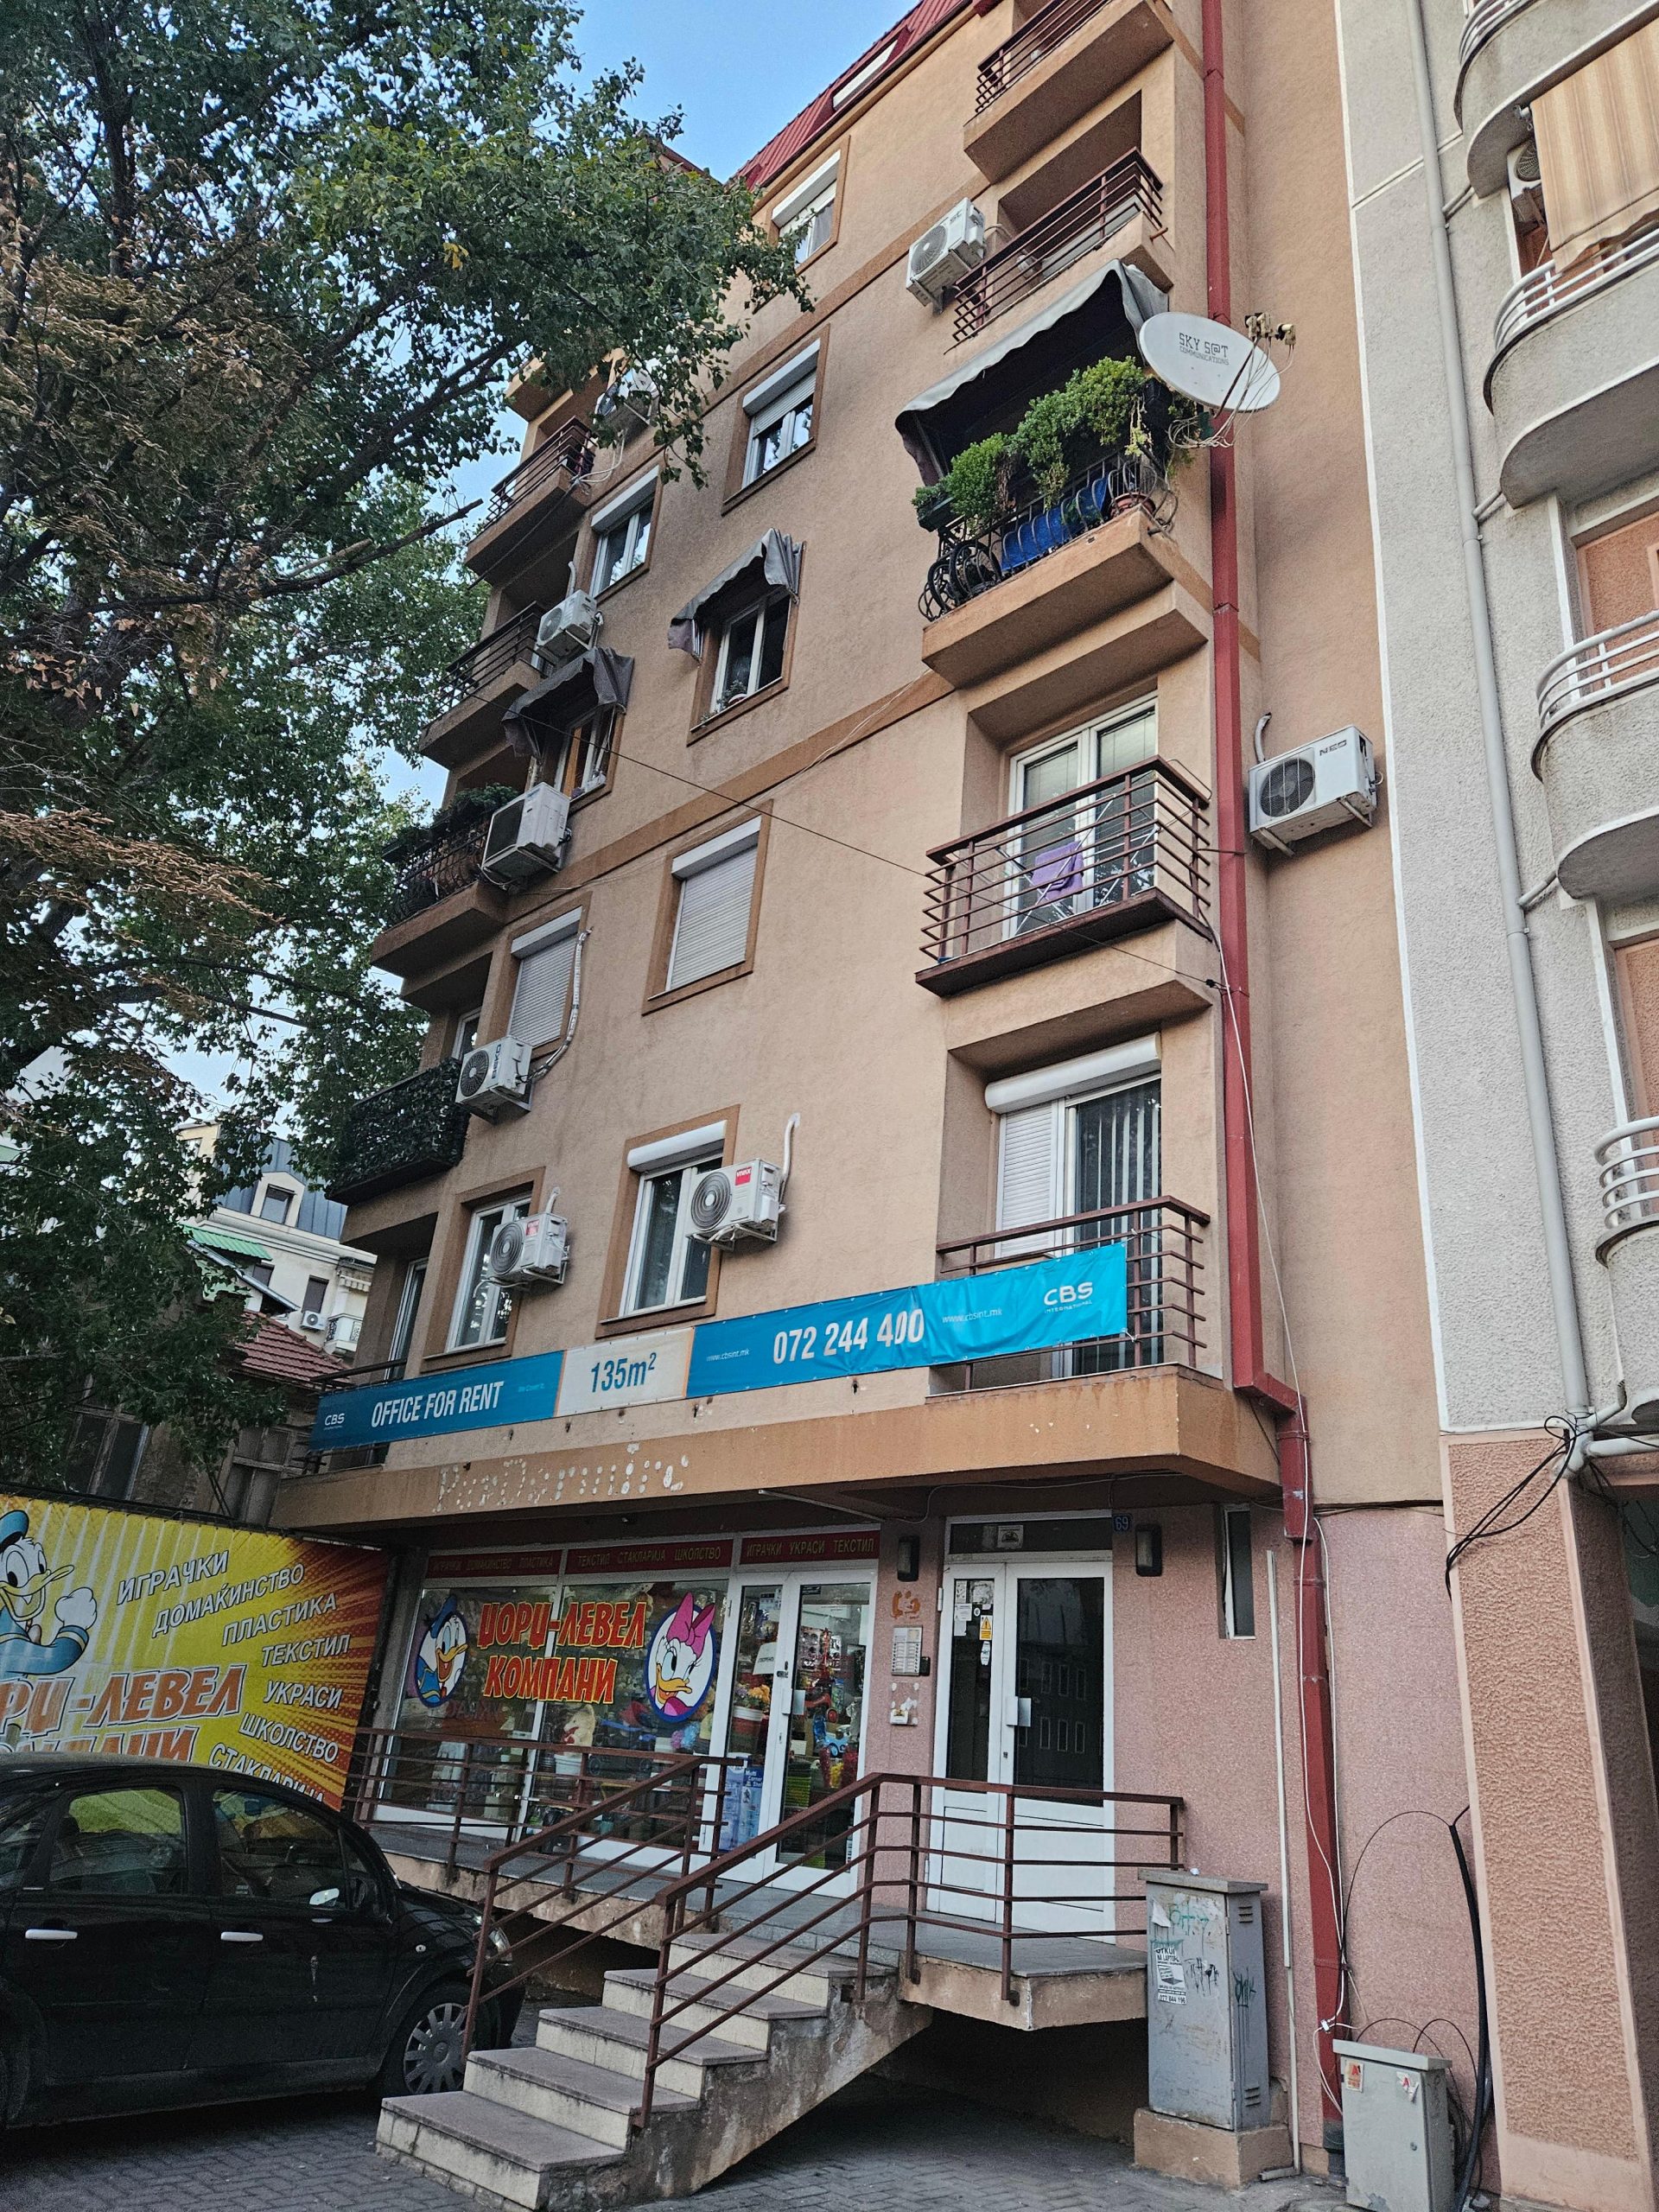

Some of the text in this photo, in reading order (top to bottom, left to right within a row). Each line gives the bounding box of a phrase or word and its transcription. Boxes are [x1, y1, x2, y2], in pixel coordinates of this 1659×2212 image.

[1179, 332, 1229, 358] SKY S@T
[1179, 346, 1230, 365] COMMUNICATIONS
[1319, 740, 1347, 756] NEO
[491, 1044, 501, 1079] BEKO
[1044, 1281, 1093, 1306] CBS
[1045, 1300, 1093, 1314] INTERNATIONAL
[773, 1308, 925, 1364] 072 244 400
[324, 1413, 345, 1427] CBS
[371, 1381, 505, 1428] OFFICE FOR RENT
[674, 1547, 721, 1561] ШКОЛСТВО
[747, 1538, 874, 1557] ИГРАЧКИ УКРАСИ ТЕКСТИЛ
[116, 1550, 229, 1605] ИГРАЧКИ
[152, 1563, 304, 1638] ДОМАЌИНСТВО
[221, 1592, 337, 1647] ПЛАСТИКА
[262, 1634, 351, 1668] ТЕКСТИЛ
[263, 1680, 343, 1710] УКРАСИ
[483, 1655, 618, 1704] КОМПАНИ
[238, 1713, 340, 1764] ШКОЛСТВО
